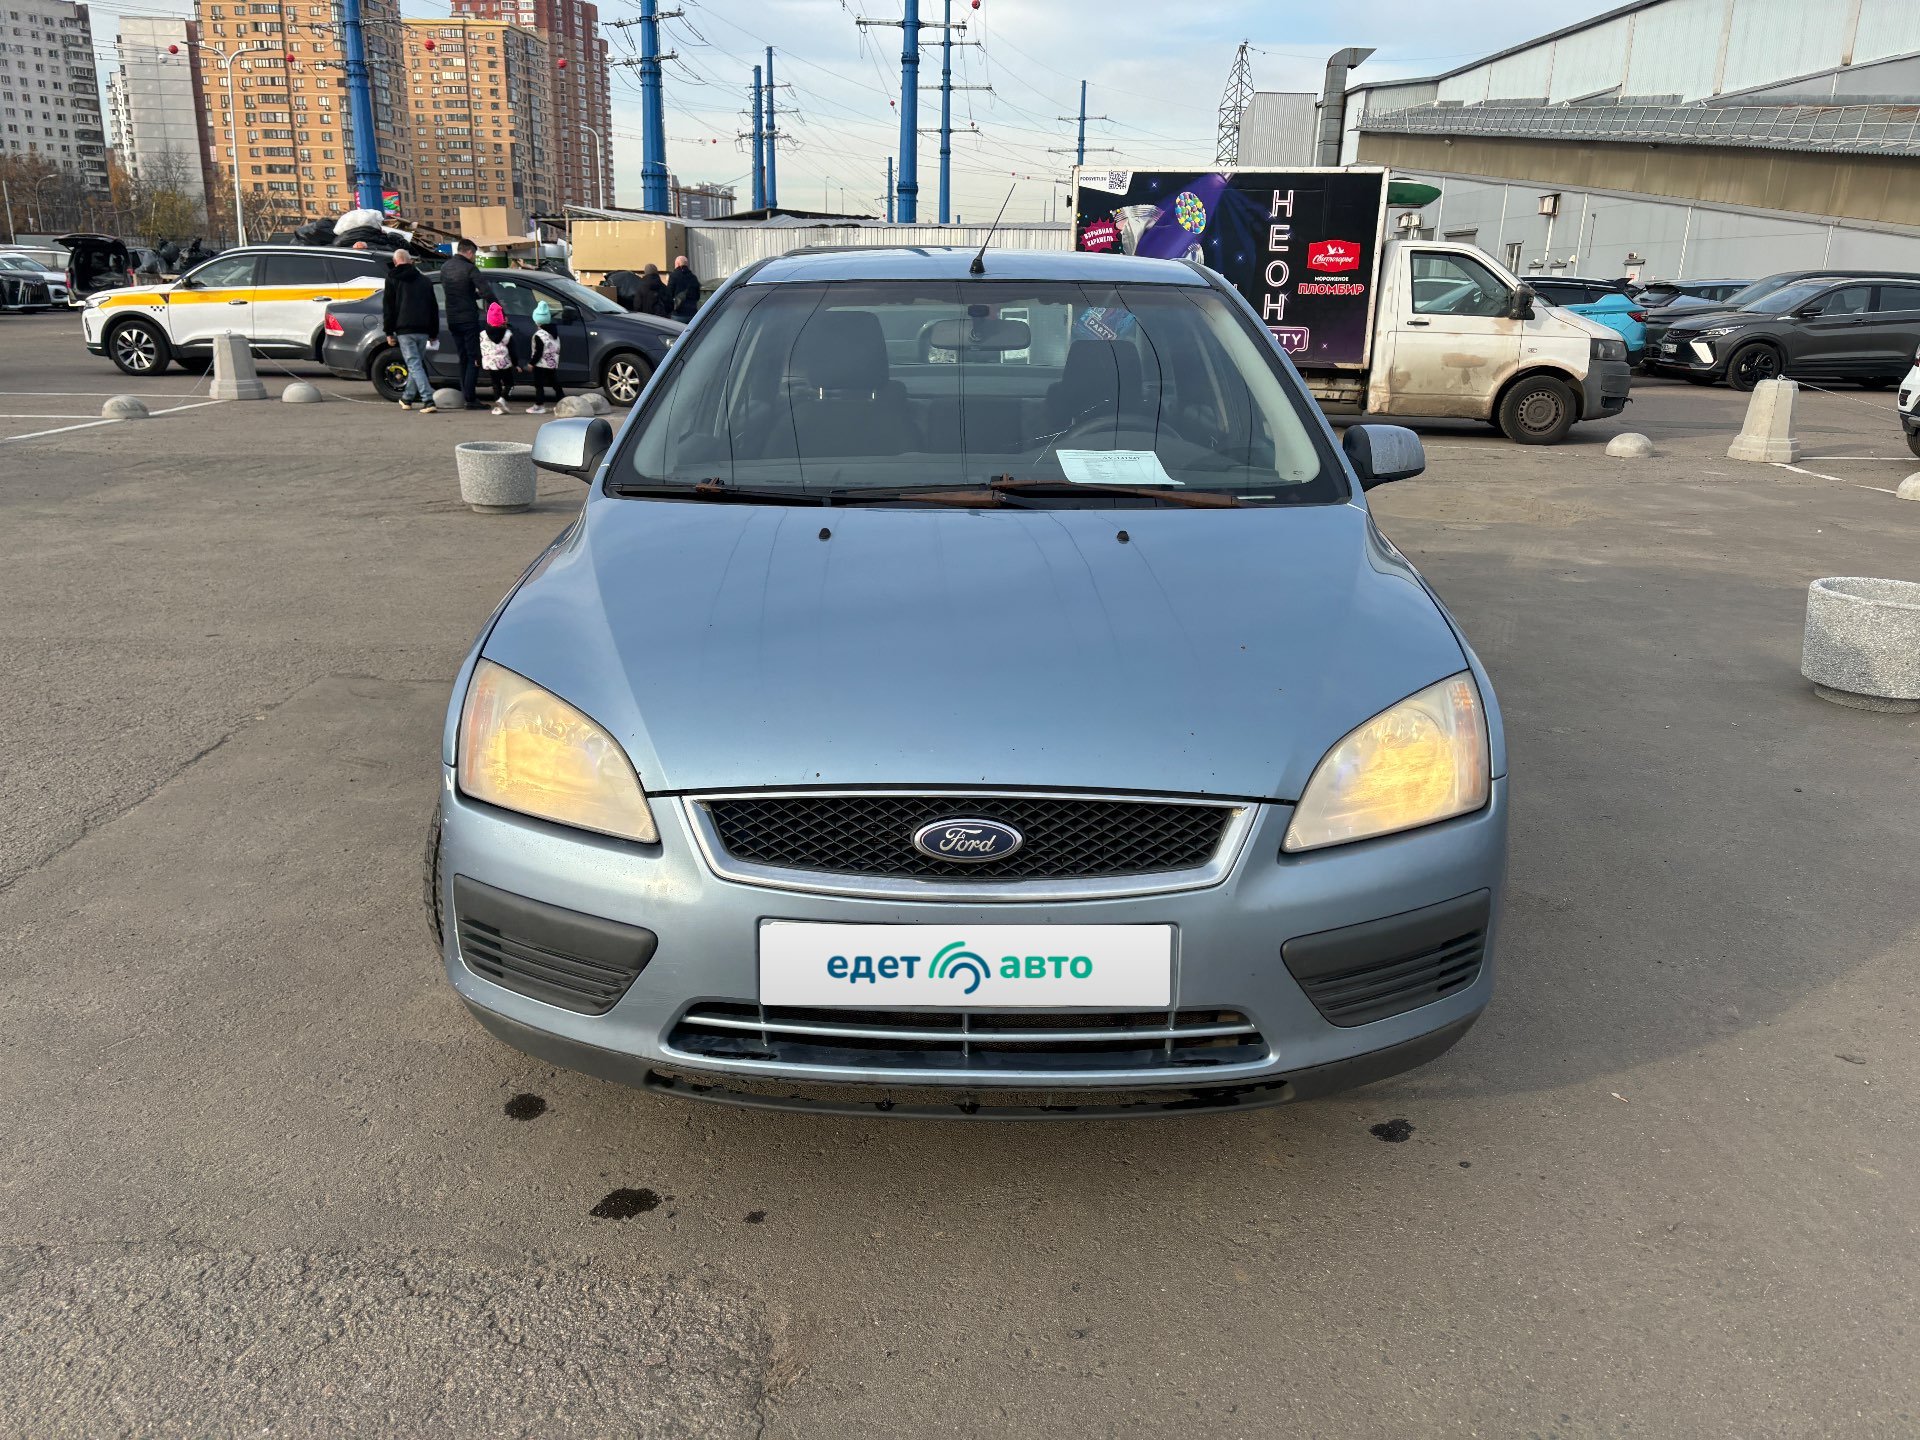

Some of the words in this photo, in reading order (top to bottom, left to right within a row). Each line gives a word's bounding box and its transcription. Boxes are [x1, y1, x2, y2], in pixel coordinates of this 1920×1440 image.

[1263, 190, 1294, 320] НЕОН
[1297, 283, 1365, 296] ПЛОМБИР
[1089, 319, 1113, 338] PARTY
[939, 827, 997, 852] Ford
